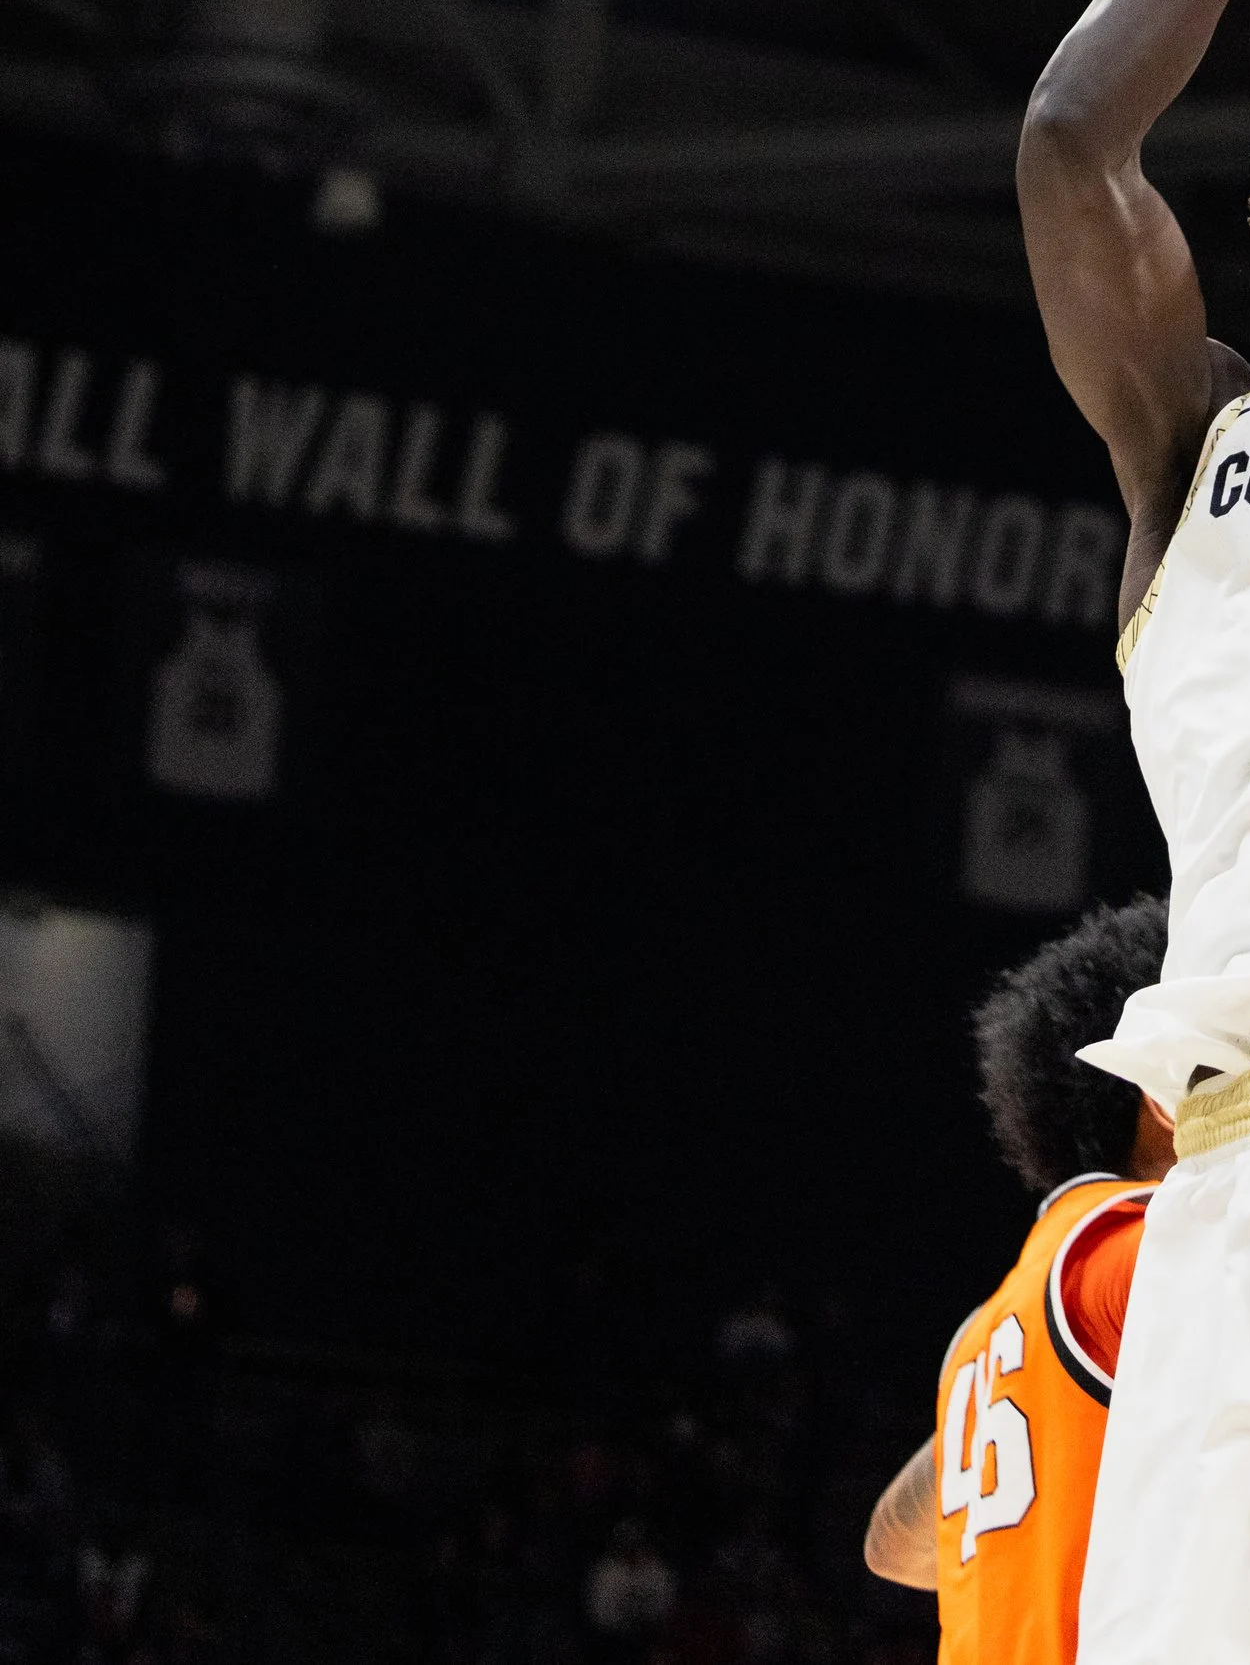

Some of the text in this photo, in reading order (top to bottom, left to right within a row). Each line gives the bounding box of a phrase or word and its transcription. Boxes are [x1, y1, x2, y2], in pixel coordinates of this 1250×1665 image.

[223, 372, 514, 540] WALL
[563, 432, 718, 566] OF
[735, 454, 1127, 629] HONOR
